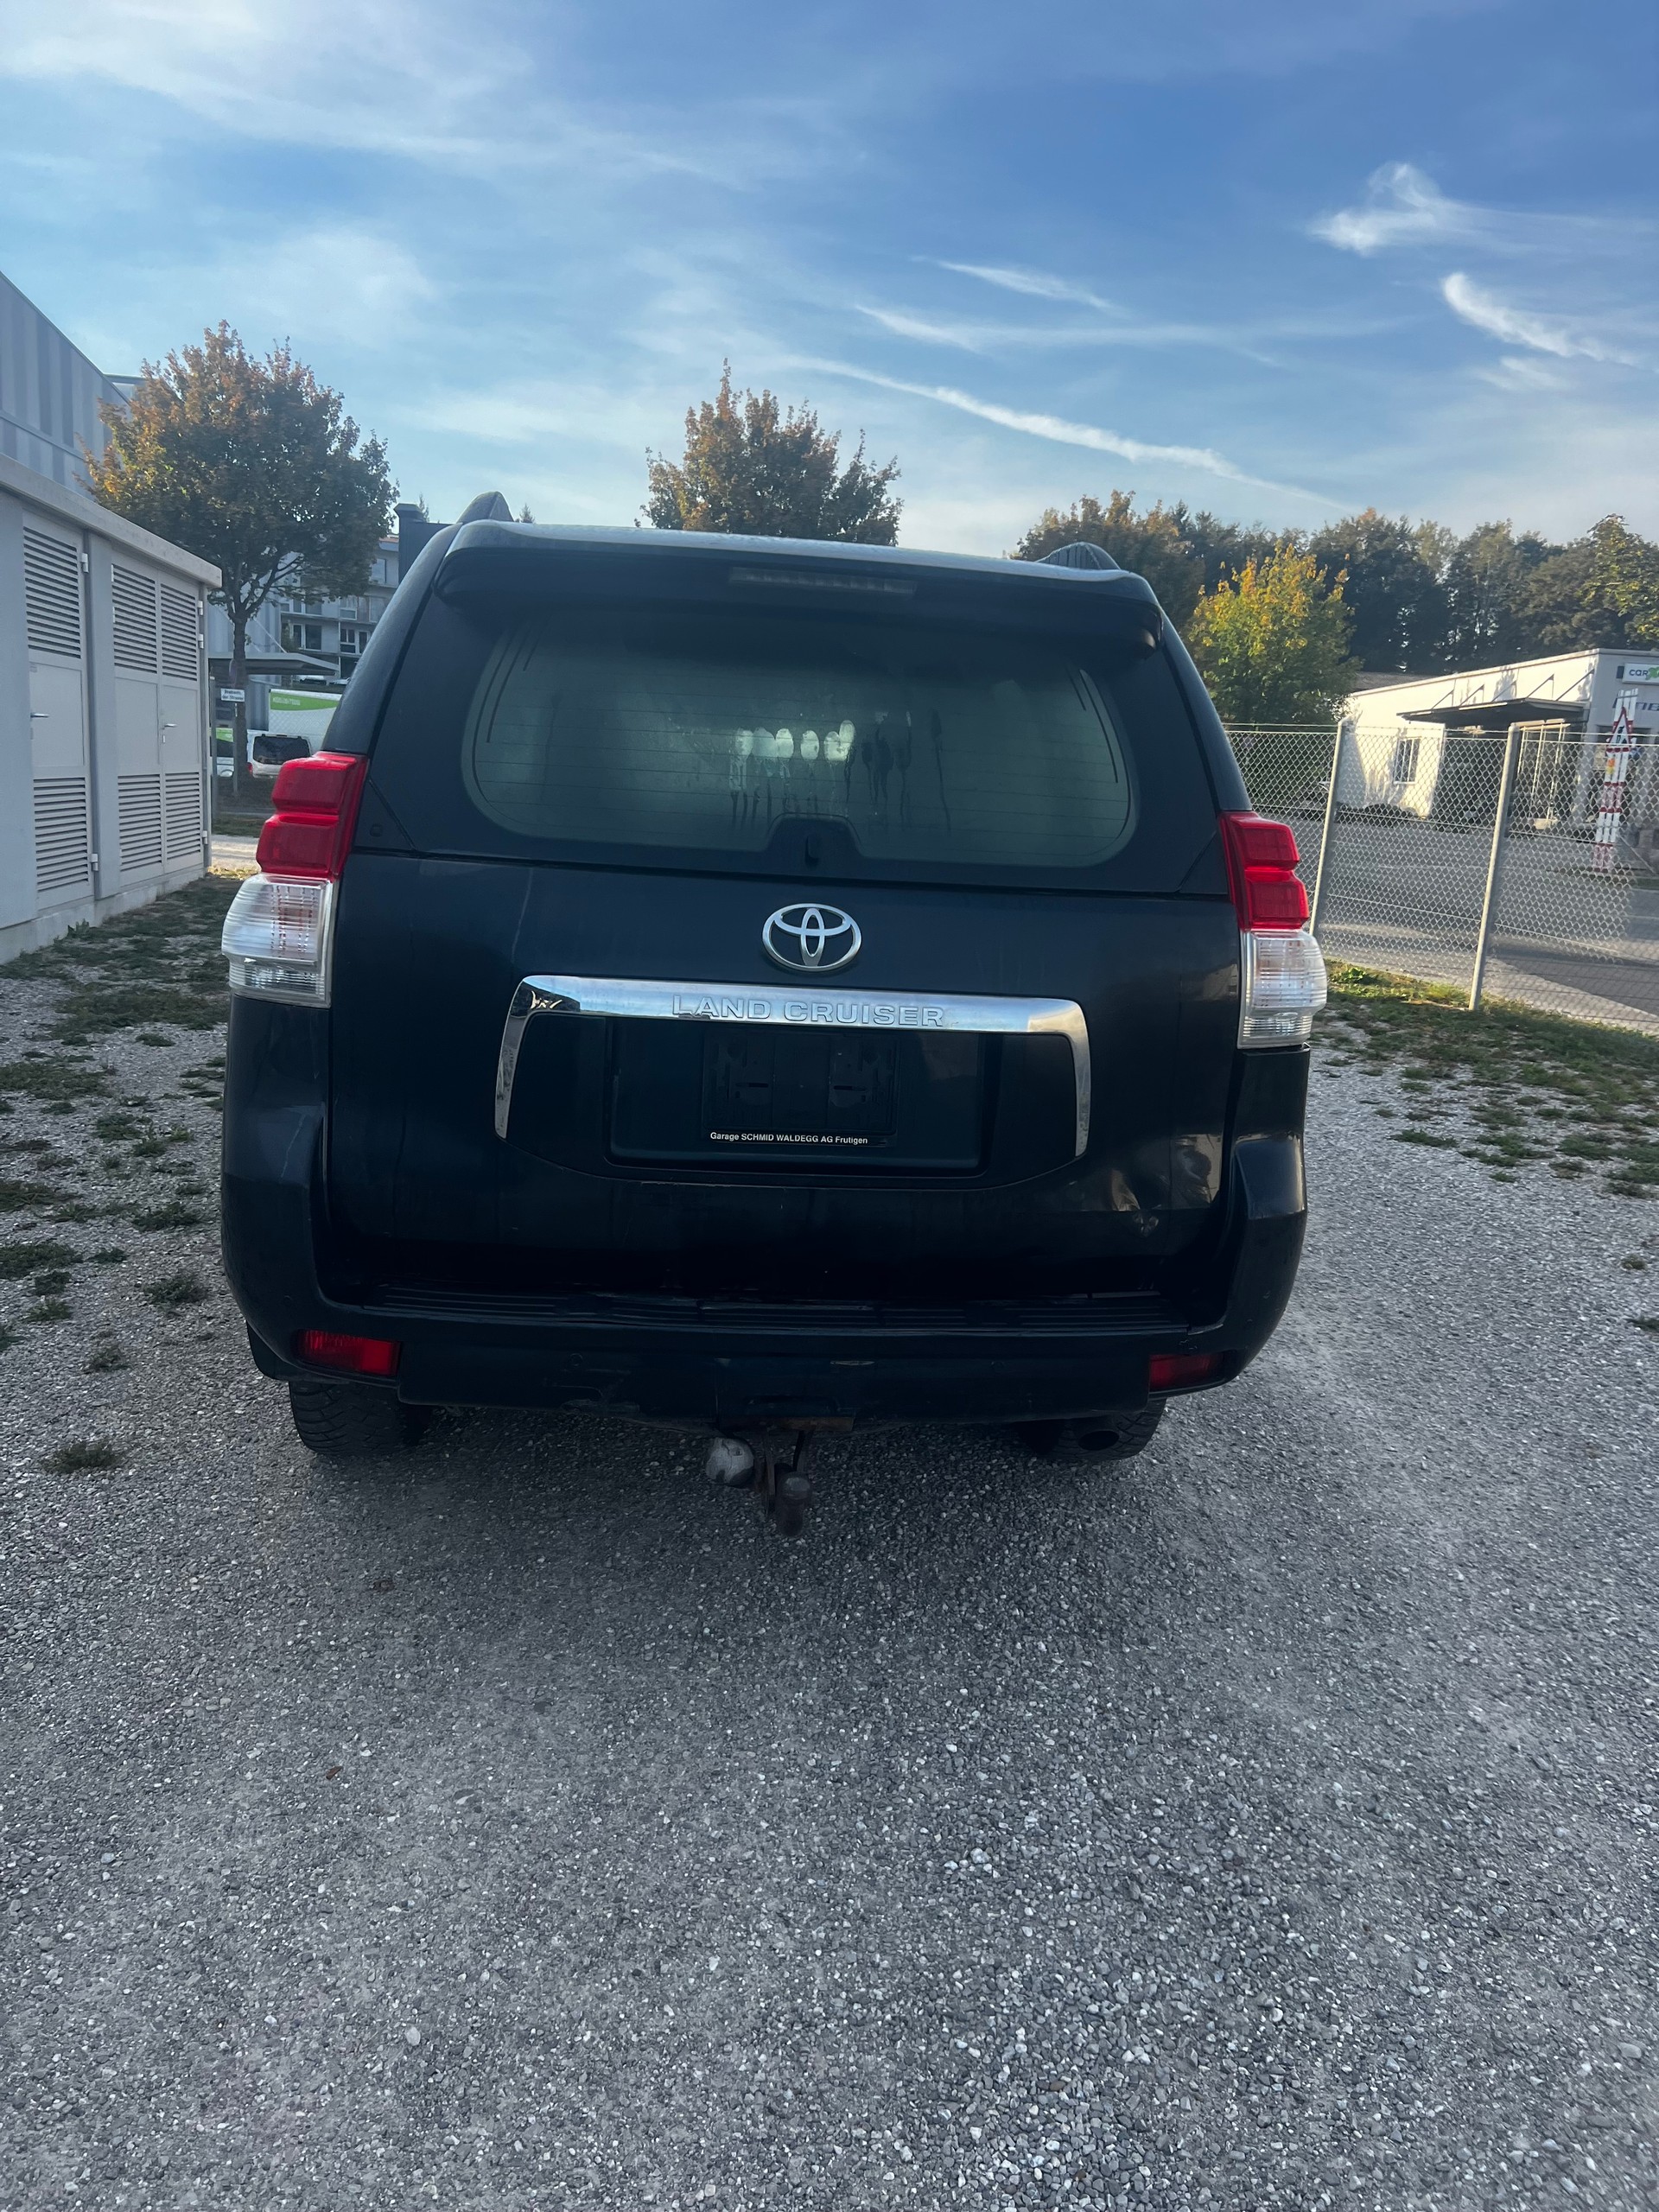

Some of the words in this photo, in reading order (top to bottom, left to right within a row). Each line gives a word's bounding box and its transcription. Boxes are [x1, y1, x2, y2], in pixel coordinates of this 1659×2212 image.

[672, 995, 771, 1020] LAND
[784, 1001, 944, 1027] CRUISER
[709, 1132, 740, 1142] Garage
[741, 1133, 774, 1141] SCHMID
[776, 1134, 819, 1143] WALDEGG
[835, 1135, 868, 1146] Frutigen
